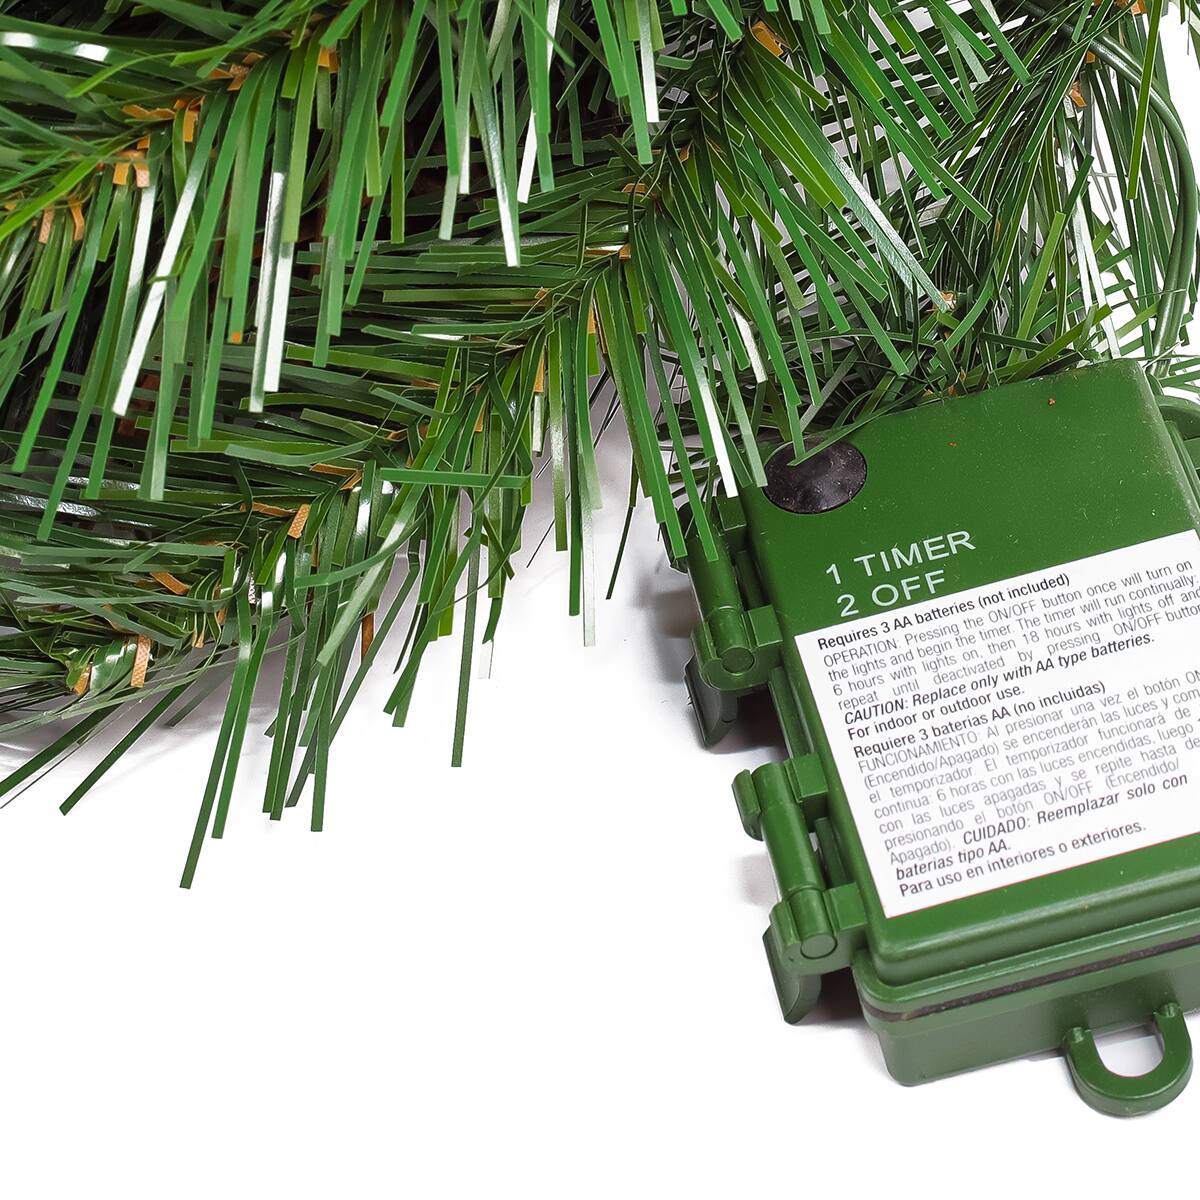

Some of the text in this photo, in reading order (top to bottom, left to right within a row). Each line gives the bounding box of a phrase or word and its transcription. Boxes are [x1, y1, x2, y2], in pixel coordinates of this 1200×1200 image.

[825, 530, 977, 585] 1 TIMER
[836, 569, 945, 617] 2 OFF
[817, 573, 1070, 651] Requires 3 AA batteries (not included)
[828, 668, 849, 682] the
[851, 658, 887, 676] lights
[890, 649, 914, 666] and
[916, 641, 953, 658] begin
[955, 634, 977, 648] the
[1017, 617, 1041, 631] The
[1044, 607, 1076, 624] timer
[1080, 599, 1102, 614] will
[1104, 595, 1126, 608] run
[904, 624, 960, 646] Pressing
[963, 617, 984, 630] the
[988, 600, 1037, 623] ON/OFF
[1041, 590, 1083, 609] button
[1086, 582, 1117, 597] once
[1121, 572, 1143, 587] will
[1146, 566, 1173, 581] turn
[1176, 562, 1193, 573] on
[833, 684, 843, 696] 6
[848, 675, 885, 693] hours
[889, 665, 917, 681] with
[921, 655, 957, 673] lights
[987, 639, 1017, 655] then
[1022, 631, 1040, 645] 18
[1044, 621, 1082, 639] hours
[1085, 612, 1114, 628] with
[1117, 602, 1156, 623] lights
[1158, 594, 1175, 609] off
[838, 690, 879, 711] repeat
[892, 678, 920, 696] until
[933, 655, 1006, 685] deactivated
[1017, 650, 1033, 663] by
[1047, 632, 1101, 657] pressing
[1113, 613, 1162, 636] ON/OFF
[912, 684, 967, 707] Replace
[971, 675, 998, 691] only
[1003, 665, 1032, 682] with
[1036, 658, 1055, 674] AA
[1058, 651, 1087, 669] type
[847, 726, 870, 741] For
[873, 713, 917, 734] indoor
[922, 709, 935, 721] or
[940, 693, 992, 716] outdoor
[853, 734, 916, 759] Requiere
[918, 728, 929, 741] 3
[992, 706, 1012, 722] AA
[1014, 701, 1036, 717] (no
[1038, 680, 1106, 708] incluidas)
[864, 742, 999, 791] (Encendido/Apagado)
[1003, 739, 1019, 751] se
[1023, 717, 1098, 745] encenderán
[1100, 711, 1121, 723] las
[1123, 700, 1158, 718] luces
[1161, 698, 1169, 710] y
[987, 725, 1000, 739] Al
[1005, 709, 1063, 736] presionar
[1070, 702, 1095, 716] una
[1099, 694, 1122, 707] vez
[1127, 687, 1140, 700] el
[1143, 678, 1181, 696] botón
[869, 790, 881, 804] el
[984, 758, 998, 772] El
[1006, 735, 1088, 766] temporizador
[1098, 713, 1166, 741] funcionará
[1174, 707, 1191, 720] de
[879, 819, 904, 834] con
[911, 812, 932, 825] las
[939, 800, 975, 817] luces
[984, 780, 1047, 806] apagadas
[1054, 776, 1062, 789] y
[1071, 770, 1087, 782] se
[1095, 757, 1133, 775] repite
[1140, 744, 1177, 762] hasta
[936, 789, 947, 802] 6
[949, 780, 987, 798] horas
[990, 773, 1014, 787] con
[1017, 766, 1037, 779] las
[1039, 756, 1075, 773] luces
[1157, 723, 1194, 741] luego
[884, 757, 1179, 852] presionando el botón ON/OFF (Encendido/
[1037, 792, 1120, 825] Reemplazar
[1127, 783, 1156, 800] solo
[1162, 775, 1188, 790] con
[899, 880, 934, 897] Para
[936, 872, 963, 887] uso
[966, 865, 985, 879] en
[987, 846, 1056, 873] interiores
[1058, 843, 1068, 853] o
[958, 847, 984, 864] tipo
